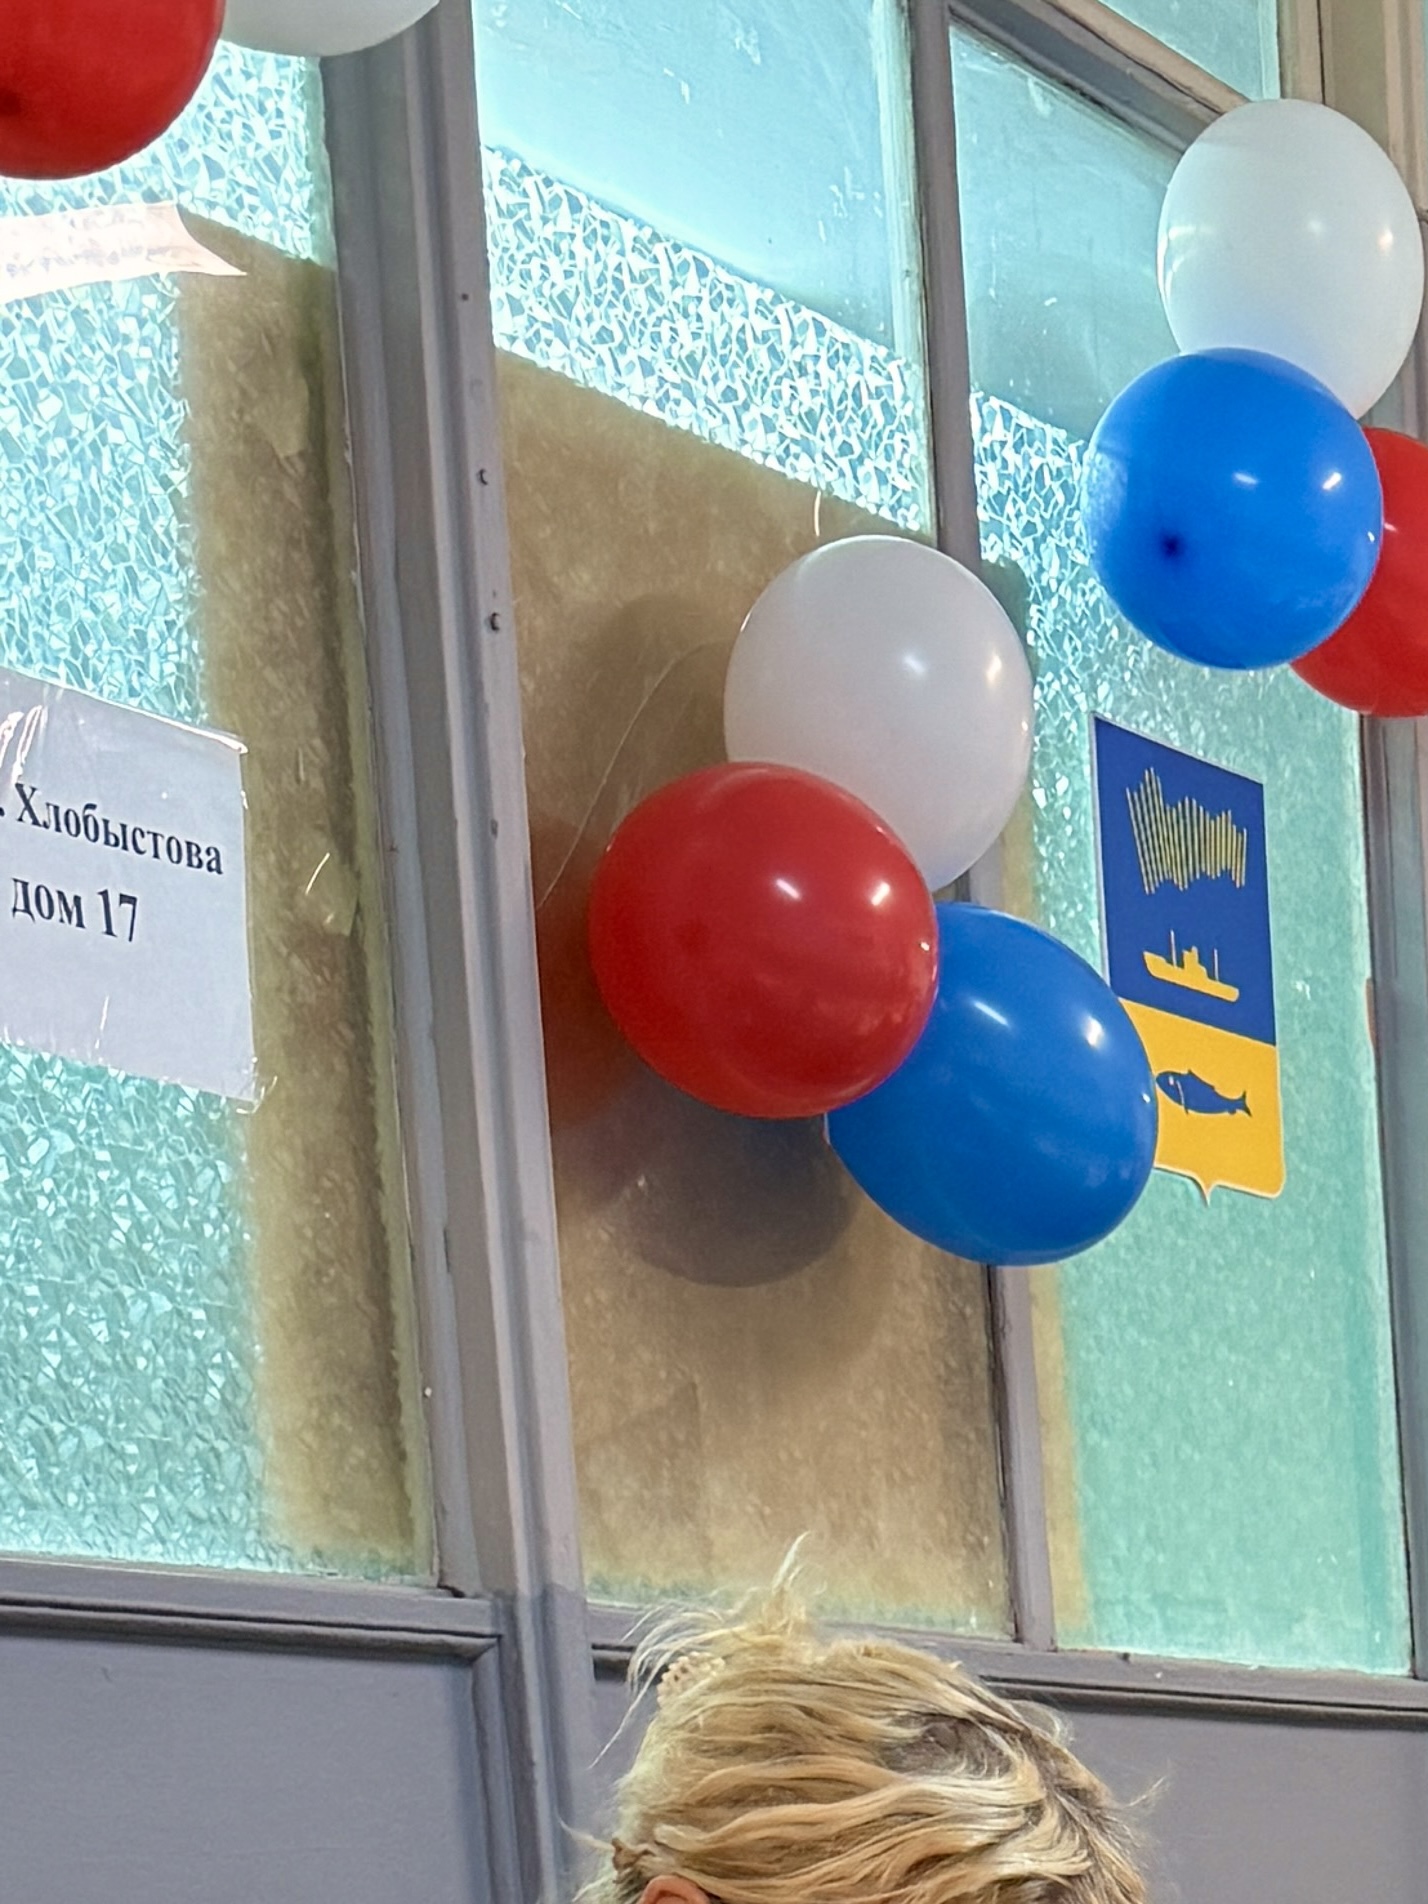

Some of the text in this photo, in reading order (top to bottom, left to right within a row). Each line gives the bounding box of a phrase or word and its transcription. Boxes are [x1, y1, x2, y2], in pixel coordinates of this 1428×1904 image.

[14, 782, 225, 877] Хлобыстова
[11, 876, 141, 943] дом 17
